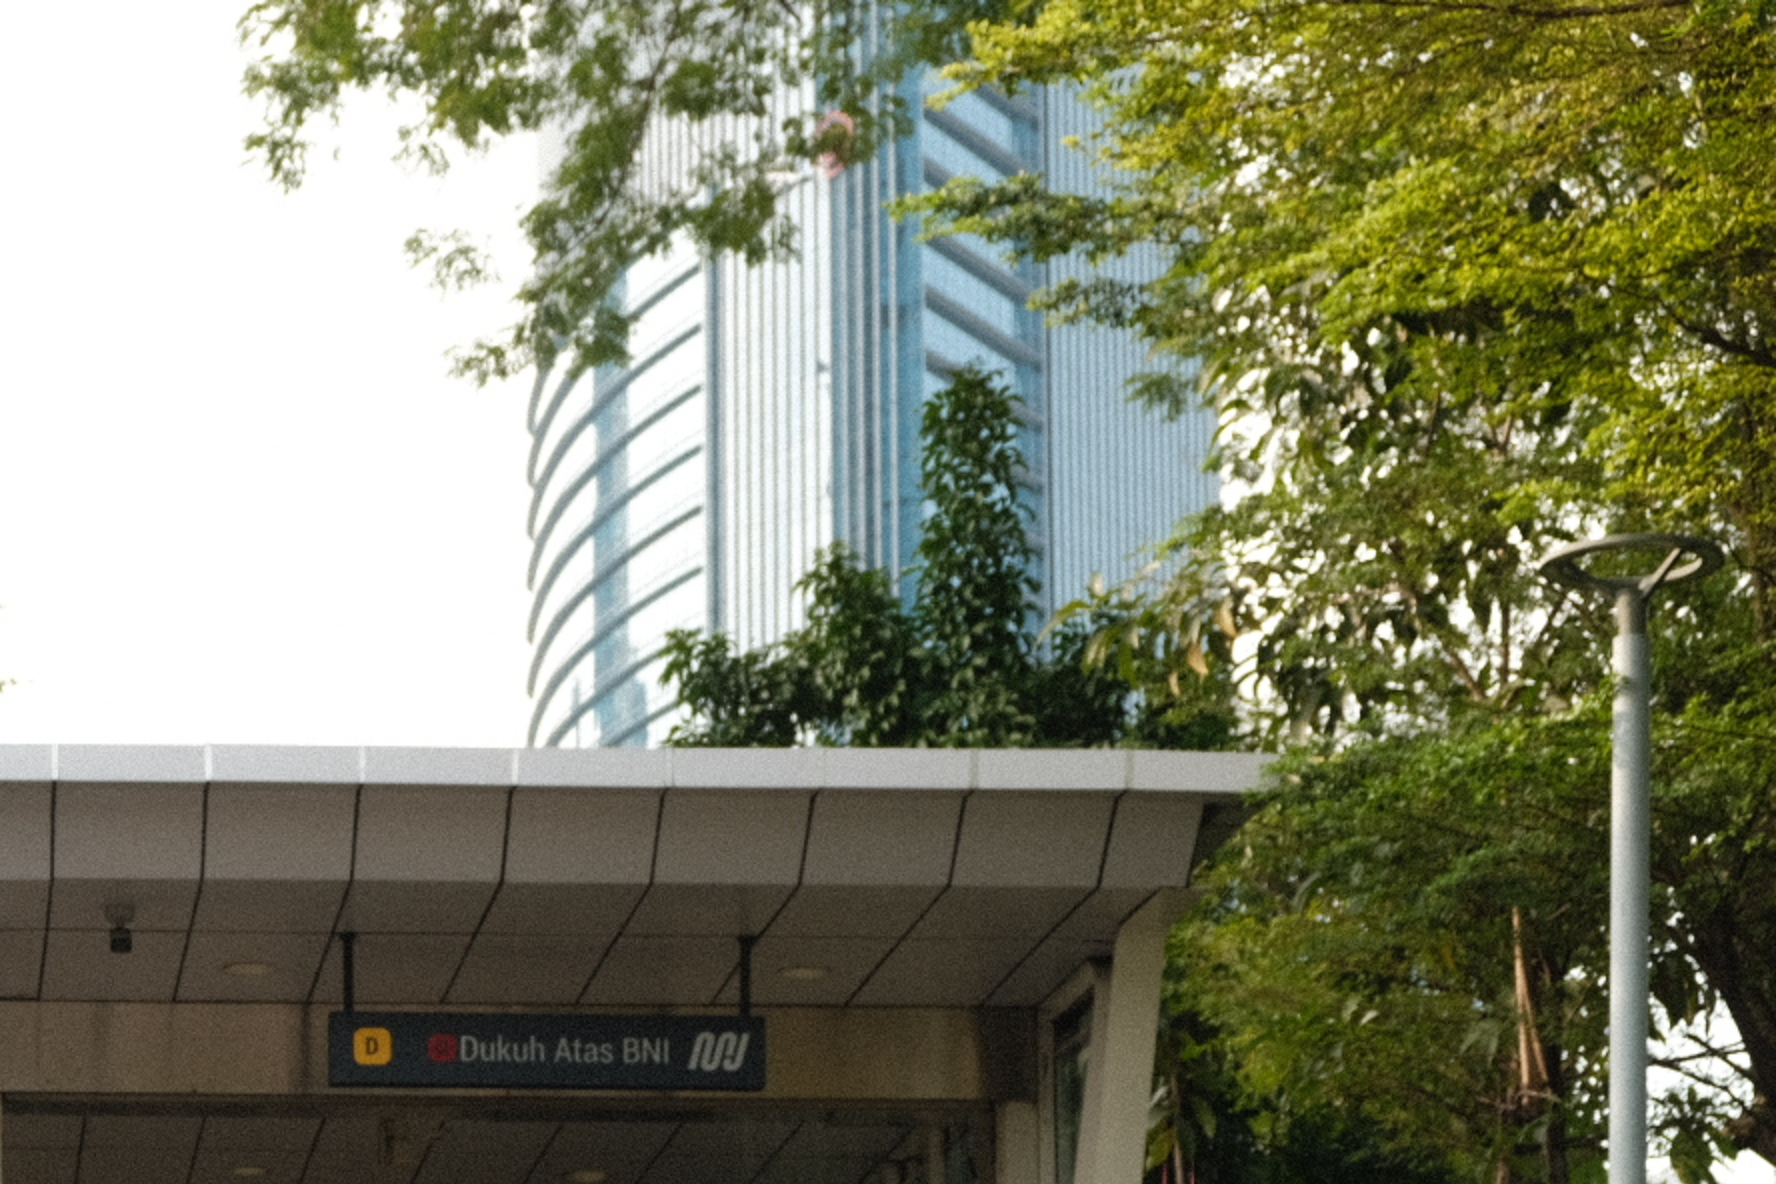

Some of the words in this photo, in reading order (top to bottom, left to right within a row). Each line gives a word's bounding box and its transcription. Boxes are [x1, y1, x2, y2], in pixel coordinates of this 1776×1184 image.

[365, 1037, 379, 1055] D
[460, 1034, 544, 1063] Dukuh
[554, 1037, 614, 1063] Atas
[623, 1037, 670, 1064] BNI
